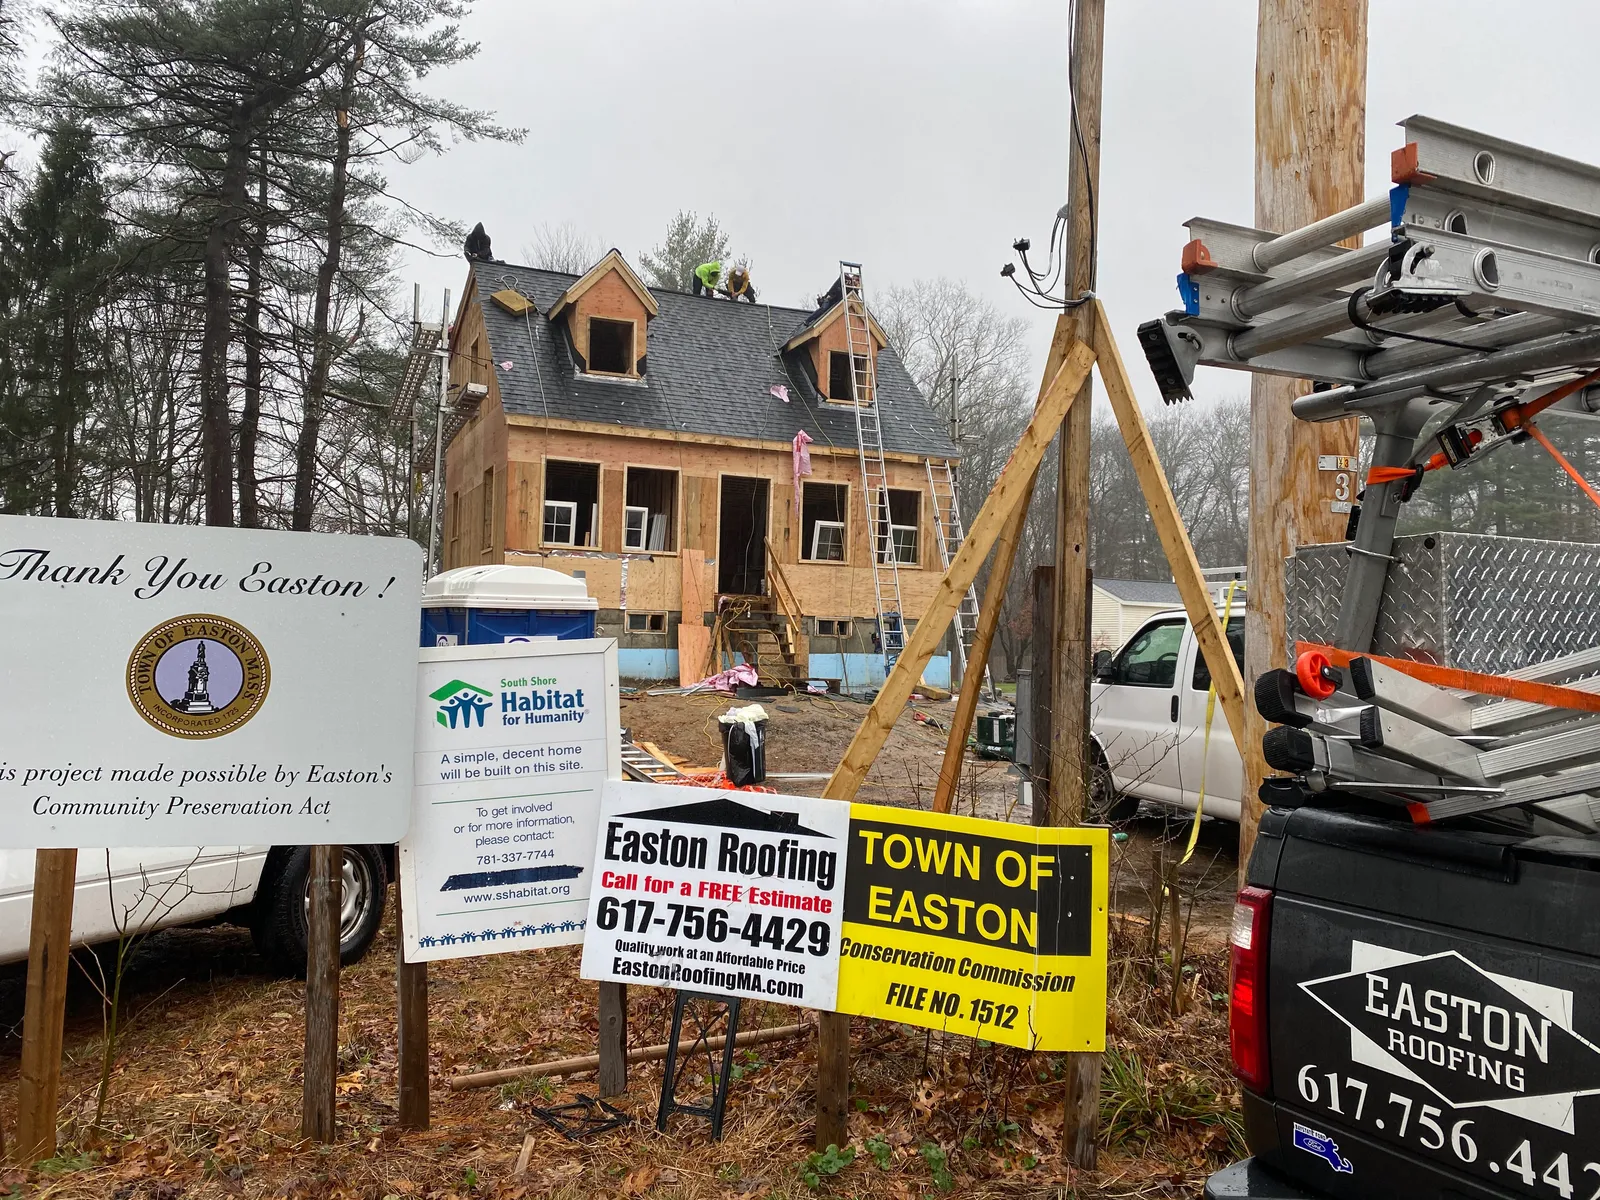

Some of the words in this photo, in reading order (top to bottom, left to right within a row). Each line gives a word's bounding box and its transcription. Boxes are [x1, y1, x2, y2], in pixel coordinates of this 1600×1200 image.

[1335, 473, 1349, 500] 3
[0, 548, 131, 586] Thank
[134, 555, 229, 600] You
[239, 561, 370, 598] Easton
[137, 651, 157, 695] TOWN
[154, 630, 176, 649] OF
[182, 624, 251, 654] EASTON
[500, 677, 528, 688] South
[530, 676, 557, 687] Shore
[501, 689, 585, 712] Habitat
[153, 703, 221, 727] INCORPORATED
[222, 706, 240, 720] 1725
[502, 713, 521, 726] for
[440, 754, 451, 765] A
[453, 751, 499, 765] simple,
[502, 747, 545, 760] decent
[548, 744, 582, 756] home
[0, 762, 17, 781] is
[21, 762, 103, 787] project
[110, 763, 174, 782] made
[178, 764, 267, 788] possible
[274, 764, 300, 788] by
[306, 764, 393, 784] Easton's
[440, 768, 461, 781] will
[465, 768, 481, 779] be
[484, 765, 511, 777] built
[514, 764, 530, 774] on
[533, 761, 556, 773] this
[559, 760, 584, 771] site.
[32, 795, 160, 820] Community
[165, 796, 293, 815] Preservation
[298, 796, 331, 815] Act
[476, 807, 488, 818] To
[491, 805, 508, 819] get
[511, 802, 553, 815] involved
[453, 824, 465, 834] or
[468, 822, 483, 833] for
[485, 819, 513, 831] more
[516, 815, 575, 829] information,
[475, 834, 510, 848] please
[513, 830, 555, 843] contact:
[476, 849, 555, 866] 781-337-7744
[604, 821, 708, 870] Easton
[717, 832, 838, 891] Roofing
[859, 829, 981, 881] TOWN
[995, 850, 1055, 891] OF
[464, 885, 570, 904] www.sshabitat.org
[601, 871, 638, 891] Call
[644, 875, 674, 894] for
[680, 882, 692, 897] a
[698, 881, 743, 902] FREE
[749, 886, 833, 914] Estimate
[596, 896, 831, 957] 617-756-4429
[868, 885, 1038, 949] EASTON
[615, 939, 656, 956] Quality
[656, 945, 684, 959] work
[686, 949, 698, 960] at
[700, 951, 713, 962] an
[715, 951, 774, 970] Affordable
[776, 959, 806, 975] Price
[840, 937, 955, 974] Conservation
[958, 957, 1076, 993] Commission
[612, 957, 804, 999] EastonRoofingMA.com
[885, 982, 928, 1011] FILE
[929, 990, 964, 1019] NO.
[969, 998, 1019, 1030] 1512
[1365, 972, 1552, 1064] EASTON
[1387, 1028, 1525, 1092] ROOFING
